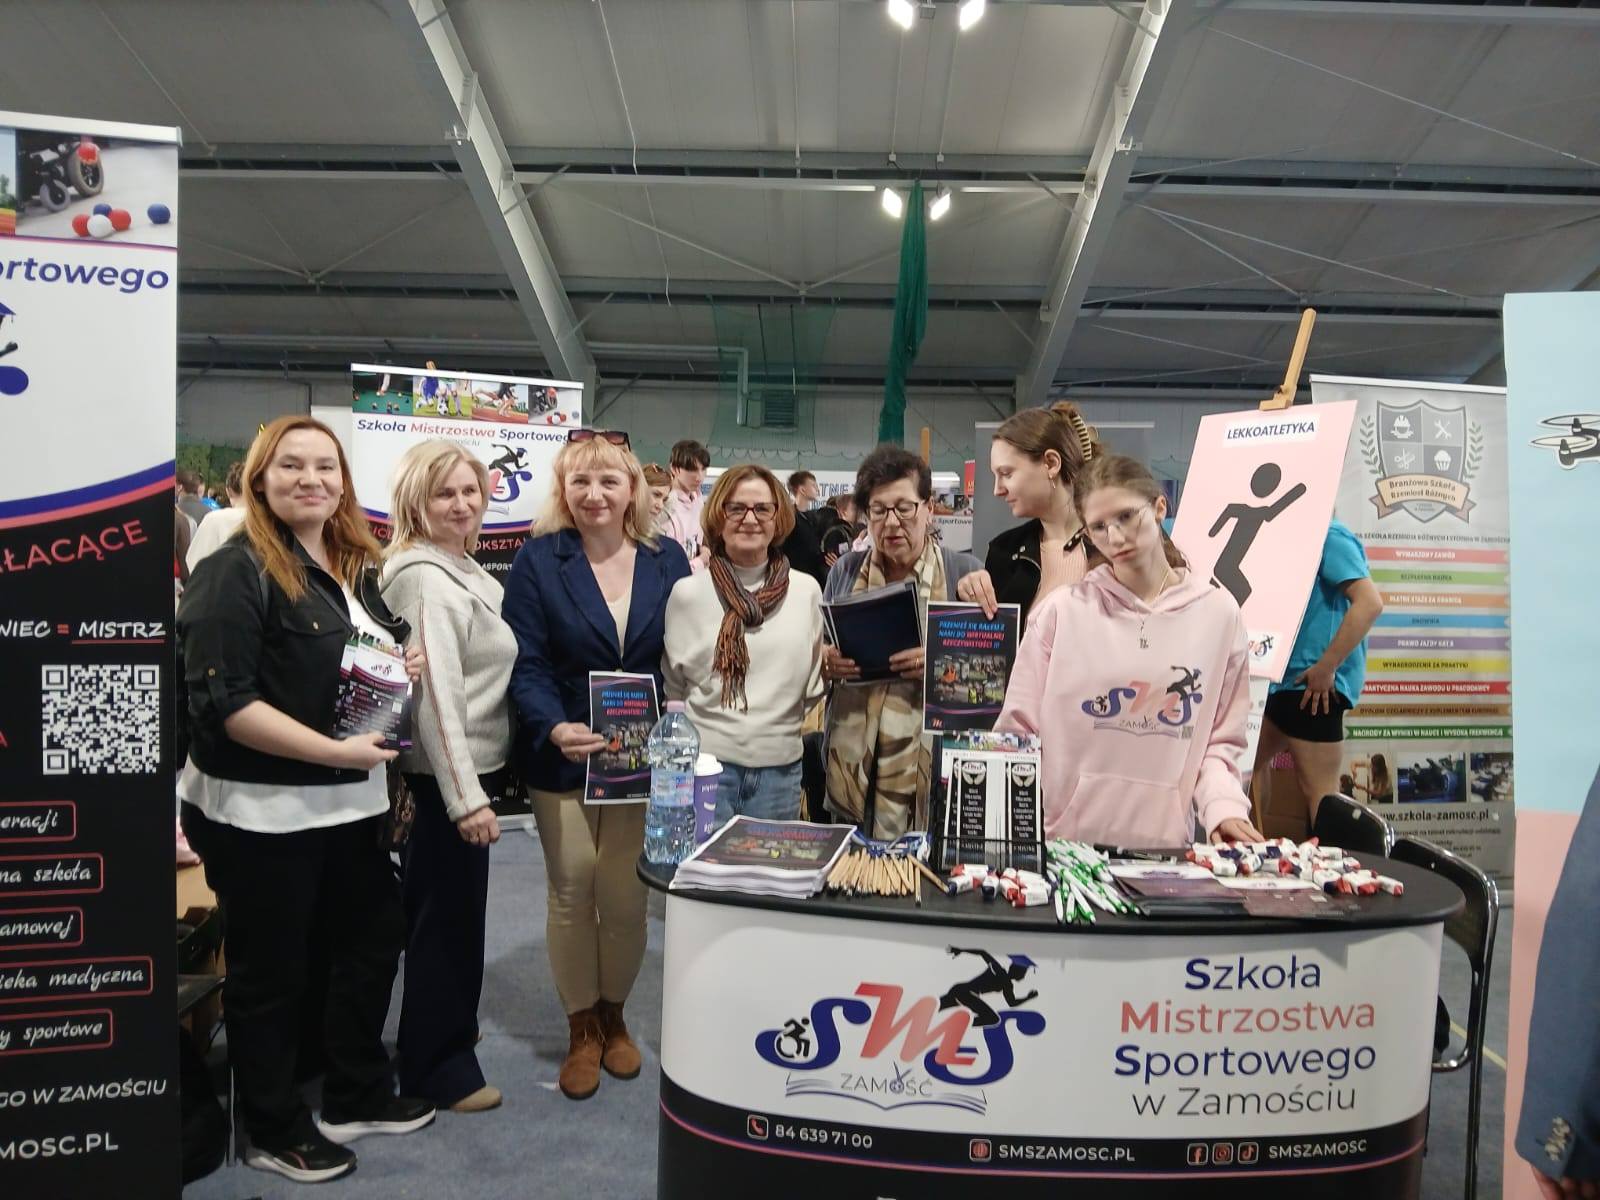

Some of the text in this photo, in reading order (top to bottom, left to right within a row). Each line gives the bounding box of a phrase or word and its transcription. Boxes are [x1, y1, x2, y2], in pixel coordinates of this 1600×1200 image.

[0, 257, 170, 294] rtowego
[357, 418, 407, 433] Szkoła
[410, 422, 496, 439] Mistrzostwa
[1226, 421, 1316, 440] LEKKOATLETYKA
[1389, 479, 1429, 489] Branżowa
[0, 520, 149, 573] ŁACĄCE
[78, 620, 167, 639] MISTRZ
[49, 964, 145, 992] medyczna
[1184, 951, 1321, 991] Szkoła
[1120, 1000, 1376, 1034] Mistrzostwa
[23, 1021, 103, 1047] sportowe
[1114, 1045, 1377, 1085] Sportowego
[33, 1087, 56, 1105] W
[58, 1077, 168, 1104] ZAMOŚCIU
[840, 1071, 933, 1098] ZAMOŚĆ
[1132, 1081, 1356, 1117] w Zamościu
[774, 1124, 873, 1149] 84 639 71 00
[998, 1138, 1368, 1162] SMSZAMOSC.PL SMSZAMOSC
